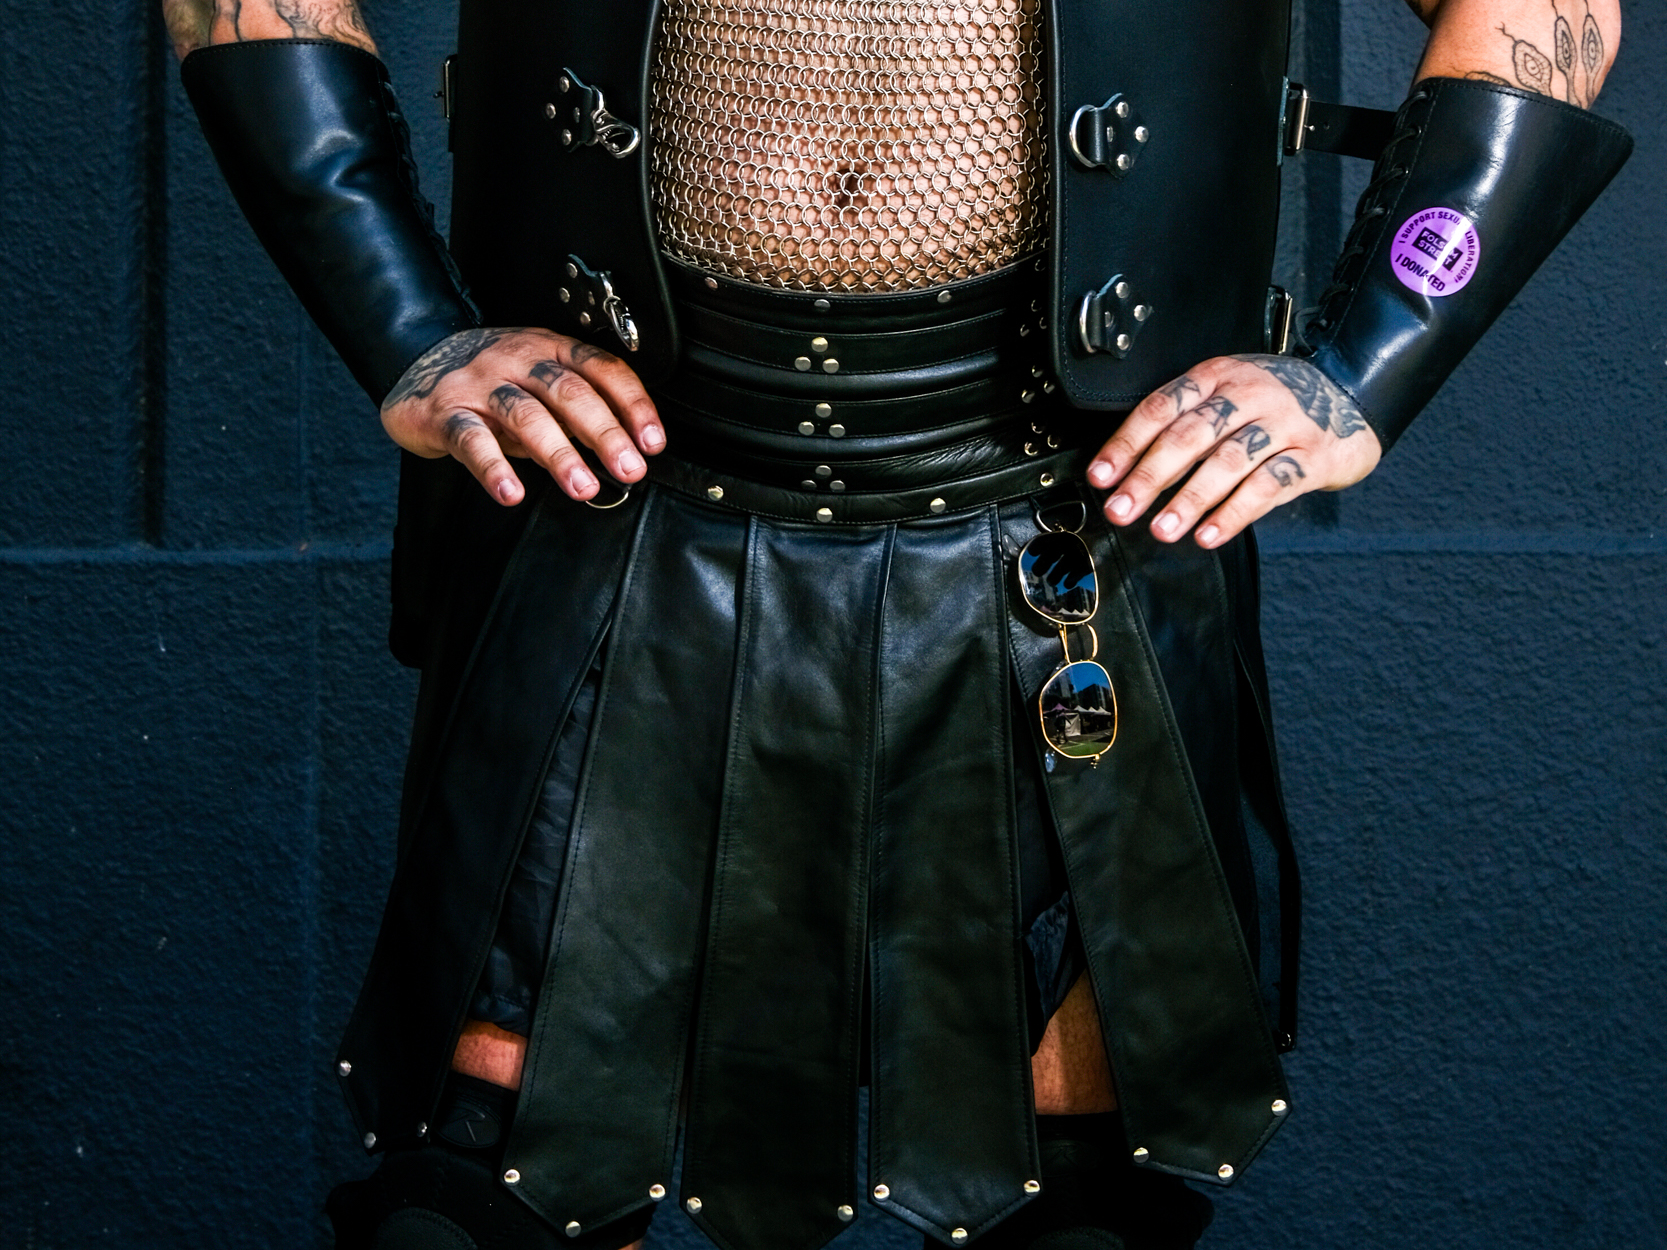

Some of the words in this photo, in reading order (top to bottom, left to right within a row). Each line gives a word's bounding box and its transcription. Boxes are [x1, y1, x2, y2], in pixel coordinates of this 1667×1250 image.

[1401, 211, 1436, 239] SUPPORT
[1437, 211, 1461, 226] SEXU
[1454, 230, 1476, 283] LIBERATION!
[1417, 239, 1453, 265] STRET
[1420, 230, 1460, 259] FOLSM
[1394, 253, 1403, 263] I
[1400, 256, 1446, 292] DONATED
